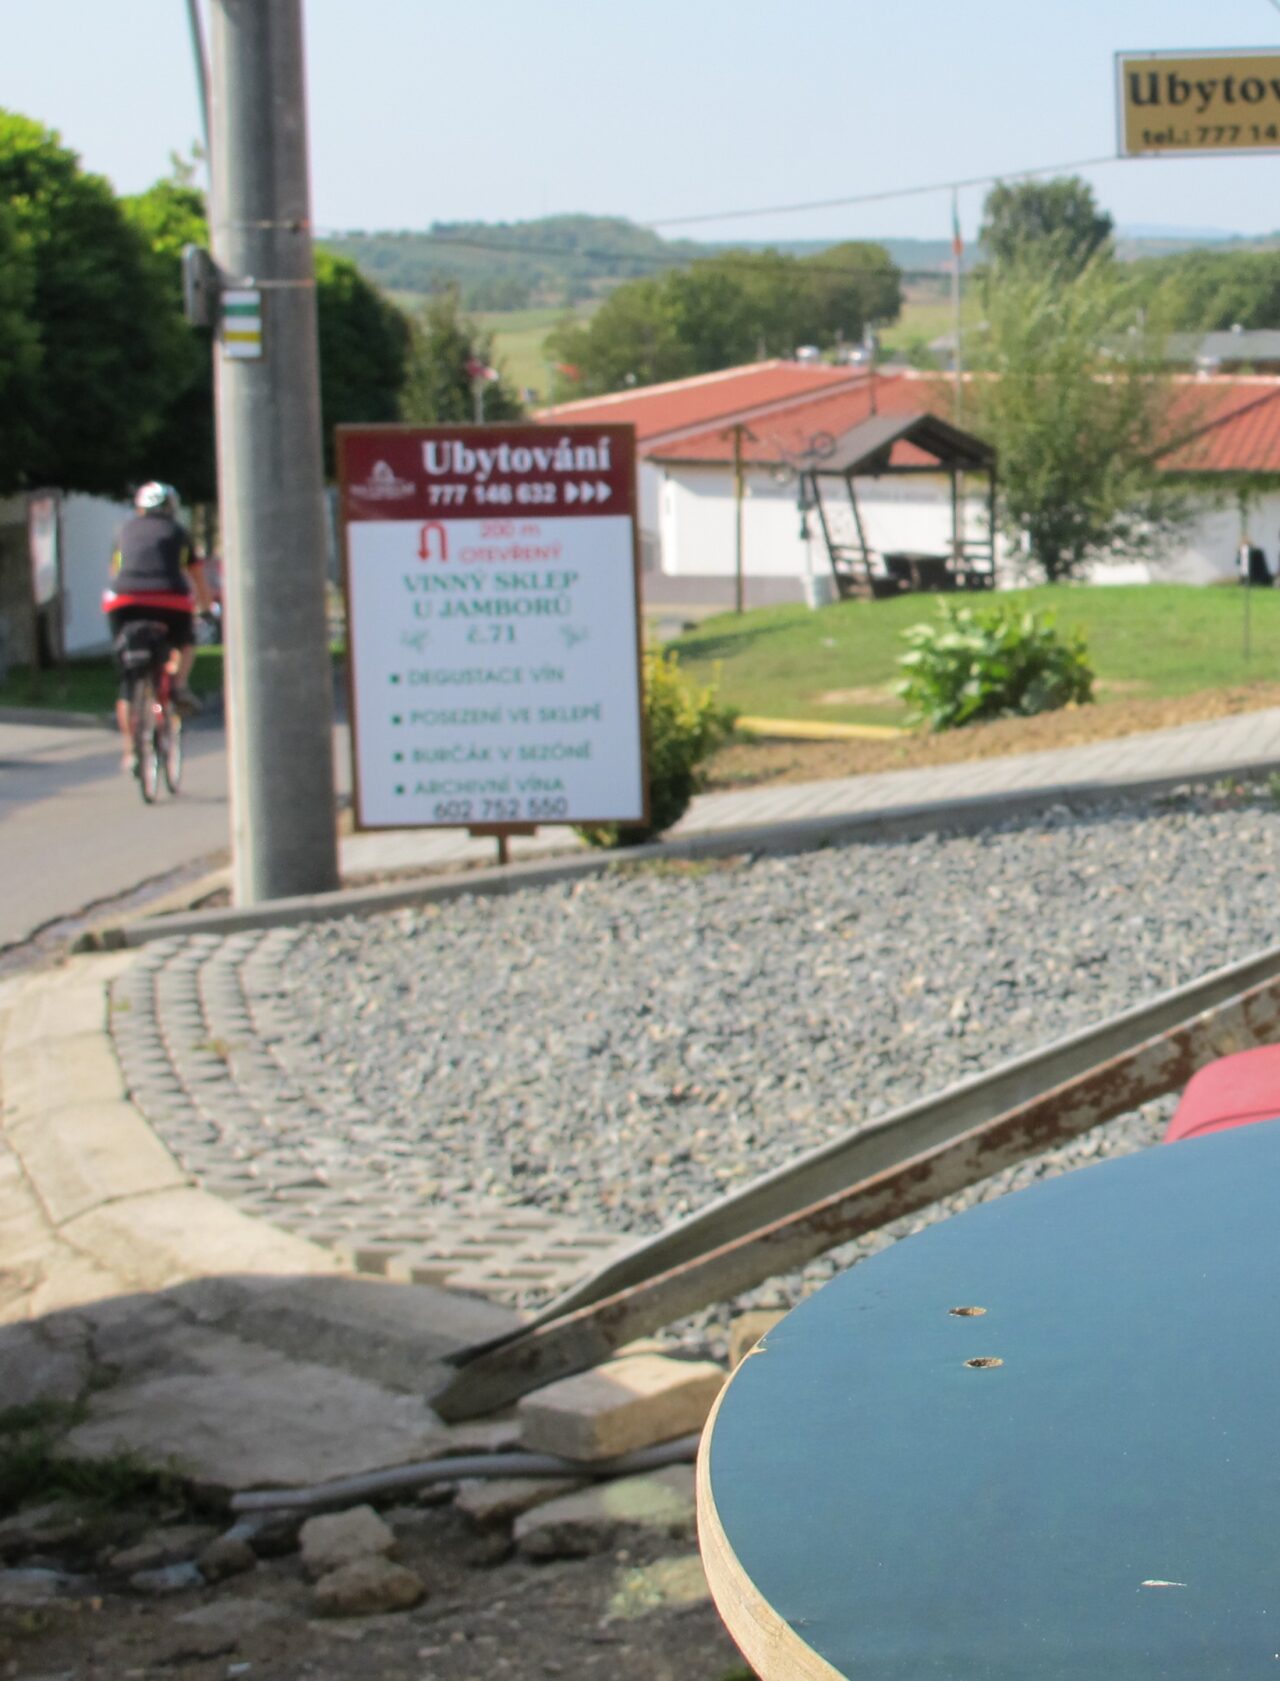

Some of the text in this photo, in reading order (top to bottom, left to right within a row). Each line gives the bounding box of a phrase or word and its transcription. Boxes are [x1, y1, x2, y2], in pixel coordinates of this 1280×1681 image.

[1197, 124, 1241, 144] 777
[1251, 123, 1279, 142] 14
[422, 436, 611, 481] Ubytování
[428, 483, 468, 506] 777
[402, 568, 579, 594] VINNÝ SKLEP
[413, 592, 572, 619] U JAMBORŮ
[407, 660, 565, 686] DEGUSTACE VÍN
[409, 700, 603, 726] POSEZENÍ VE SKLEPĚ
[412, 741, 491, 764] BURČÁK
[498, 745, 513, 762] V
[413, 771, 566, 796] ARCHIVNÍ VÍNA
[433, 796, 569, 821] 602 752 550
